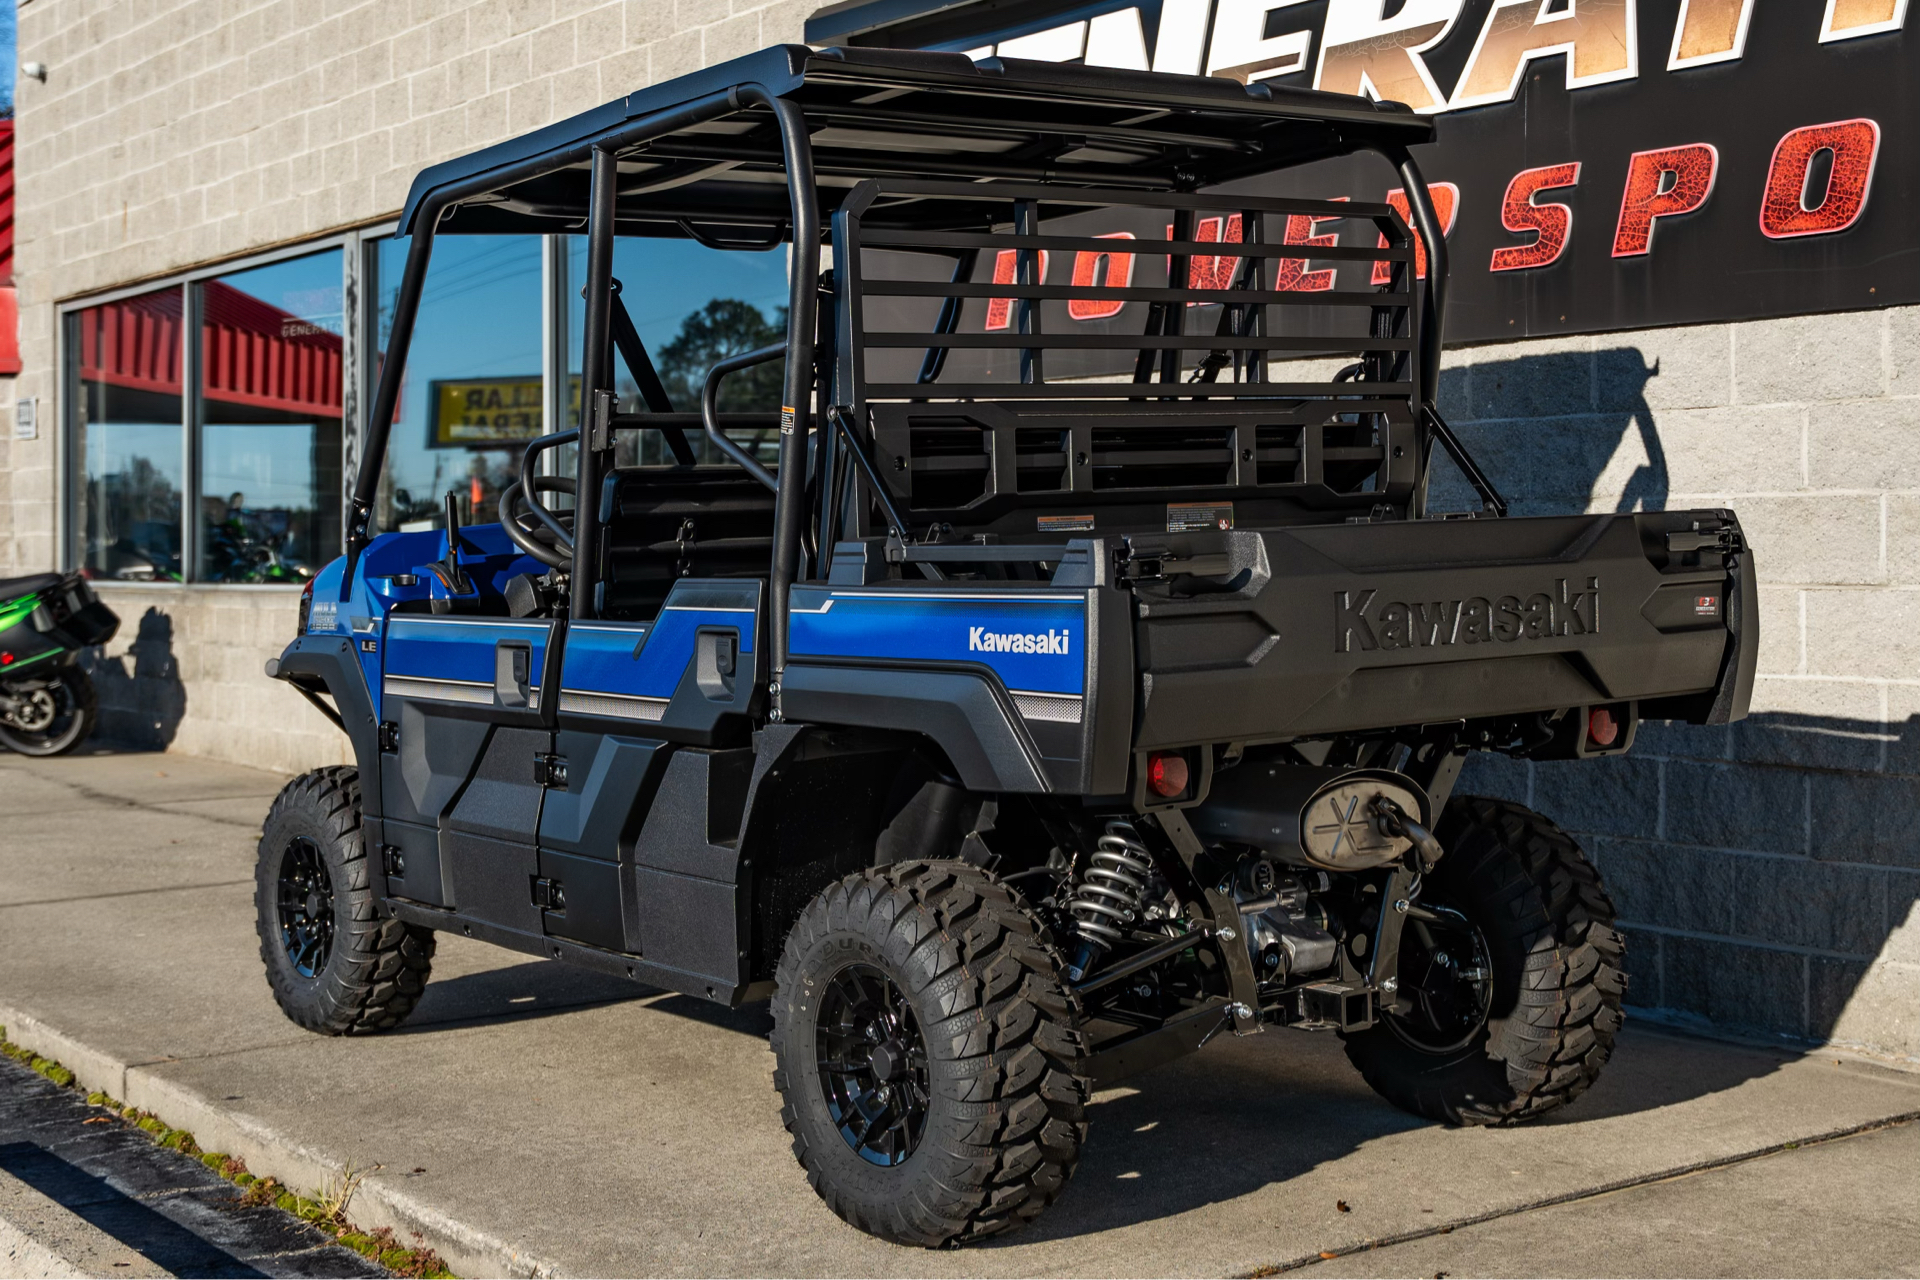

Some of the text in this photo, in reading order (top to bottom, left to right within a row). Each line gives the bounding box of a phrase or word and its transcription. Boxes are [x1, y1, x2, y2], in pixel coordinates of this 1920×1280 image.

[1334, 577, 1599, 653] Kawasaki
[361, 641, 377, 652] LE
[969, 627, 1069, 655] Kawasaki
[822, 938, 891, 968] DURO
